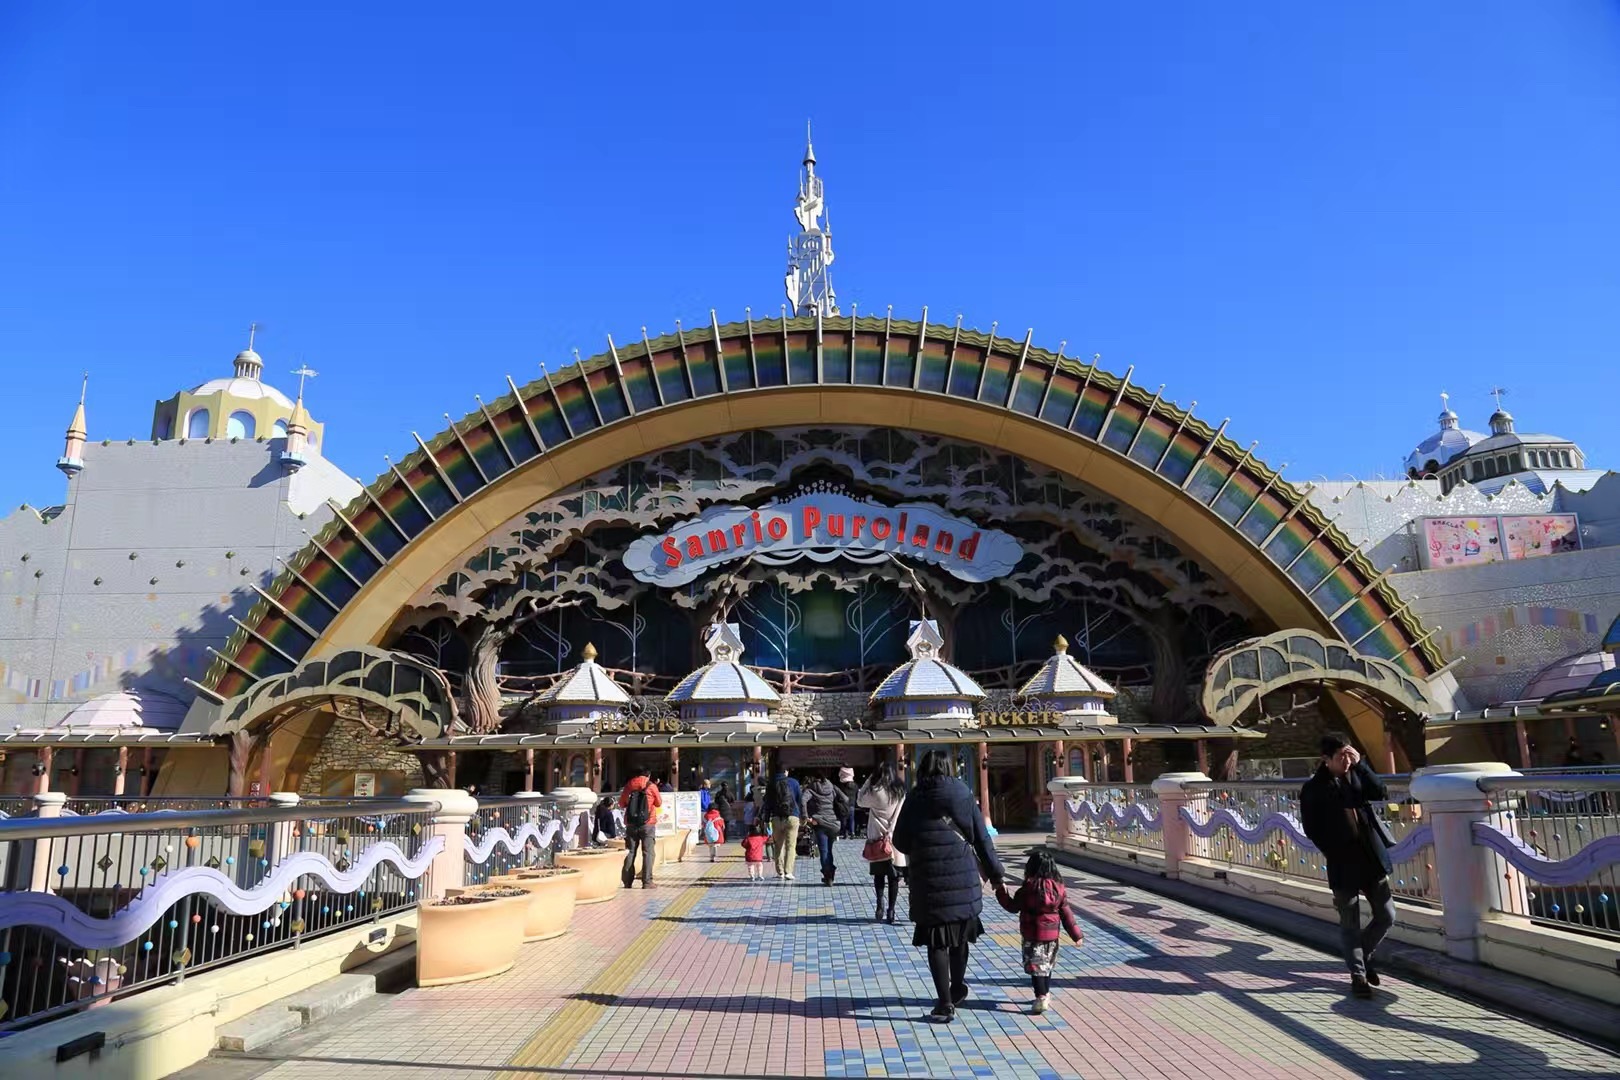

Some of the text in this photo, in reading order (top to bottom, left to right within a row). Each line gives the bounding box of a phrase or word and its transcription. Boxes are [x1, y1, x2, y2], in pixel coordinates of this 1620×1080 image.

[662, 505, 981, 568] Sanrio Puroland
[978, 711, 1064, 725] TICKETS
